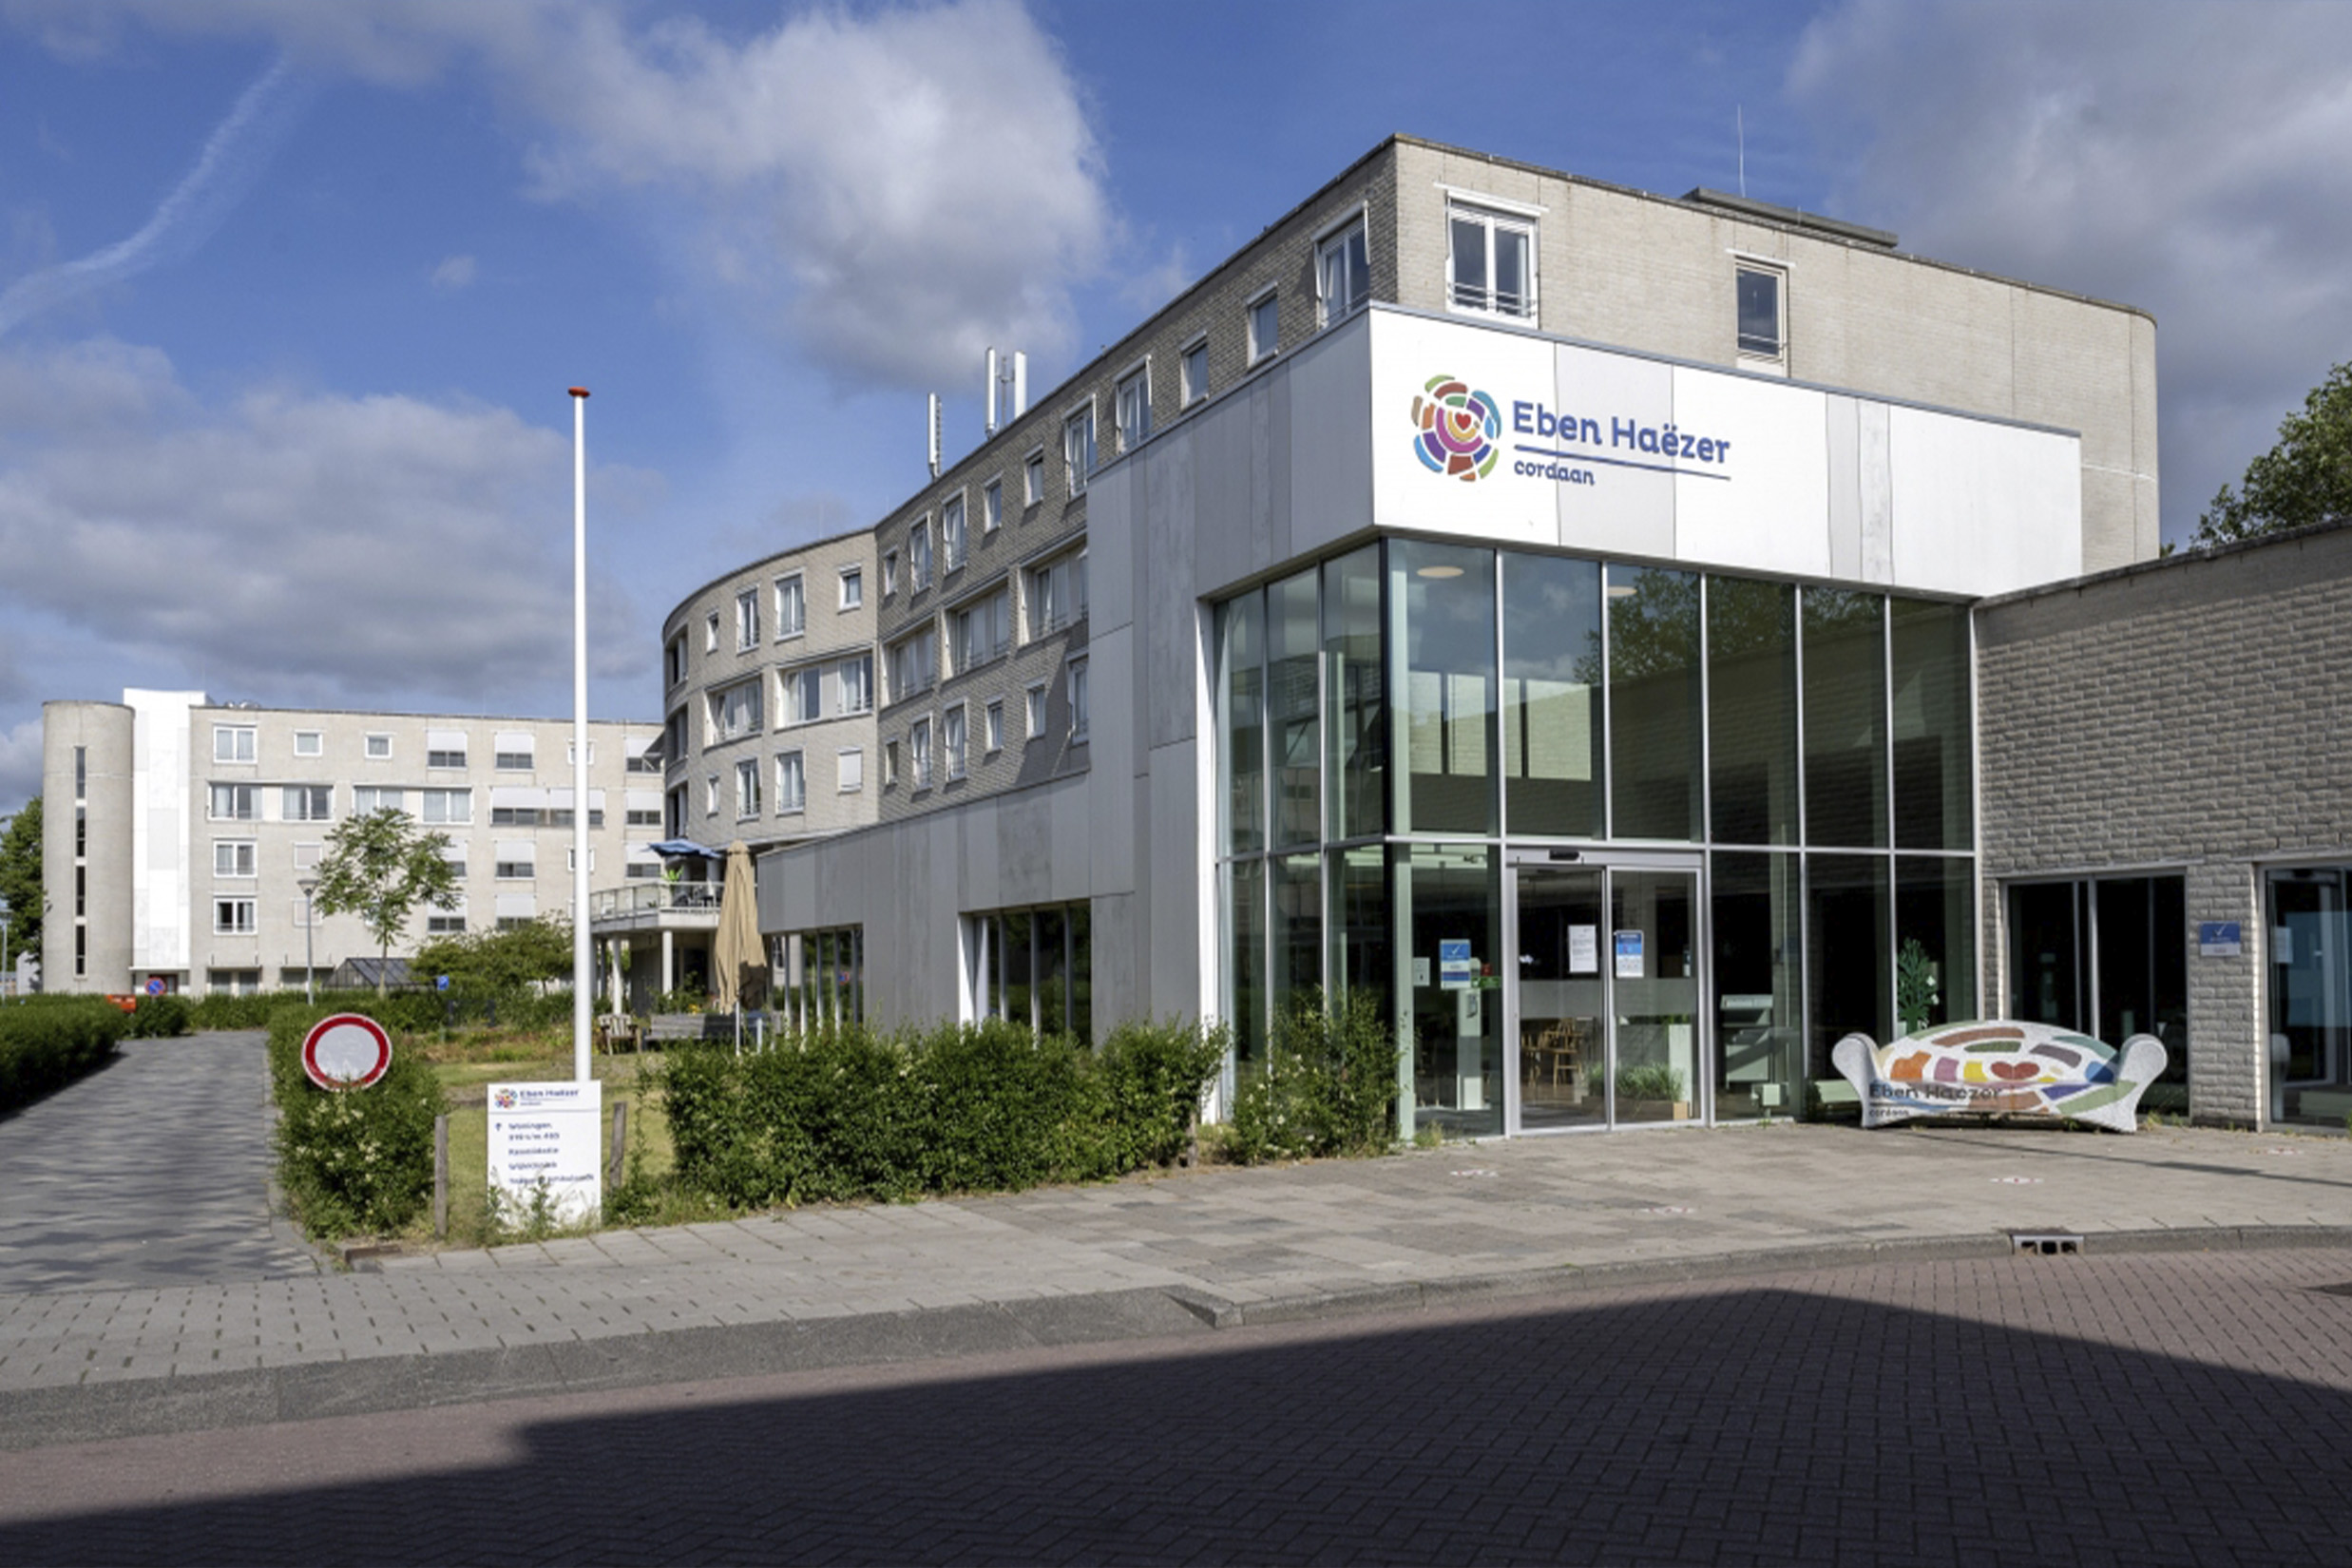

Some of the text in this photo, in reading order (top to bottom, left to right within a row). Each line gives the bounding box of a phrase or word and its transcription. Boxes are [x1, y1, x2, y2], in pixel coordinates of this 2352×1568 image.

[1513, 400, 1731, 464] Eben Haëzer
[1514, 460, 1595, 486] cordaan
[1869, 1083, 1919, 1099] Eben
